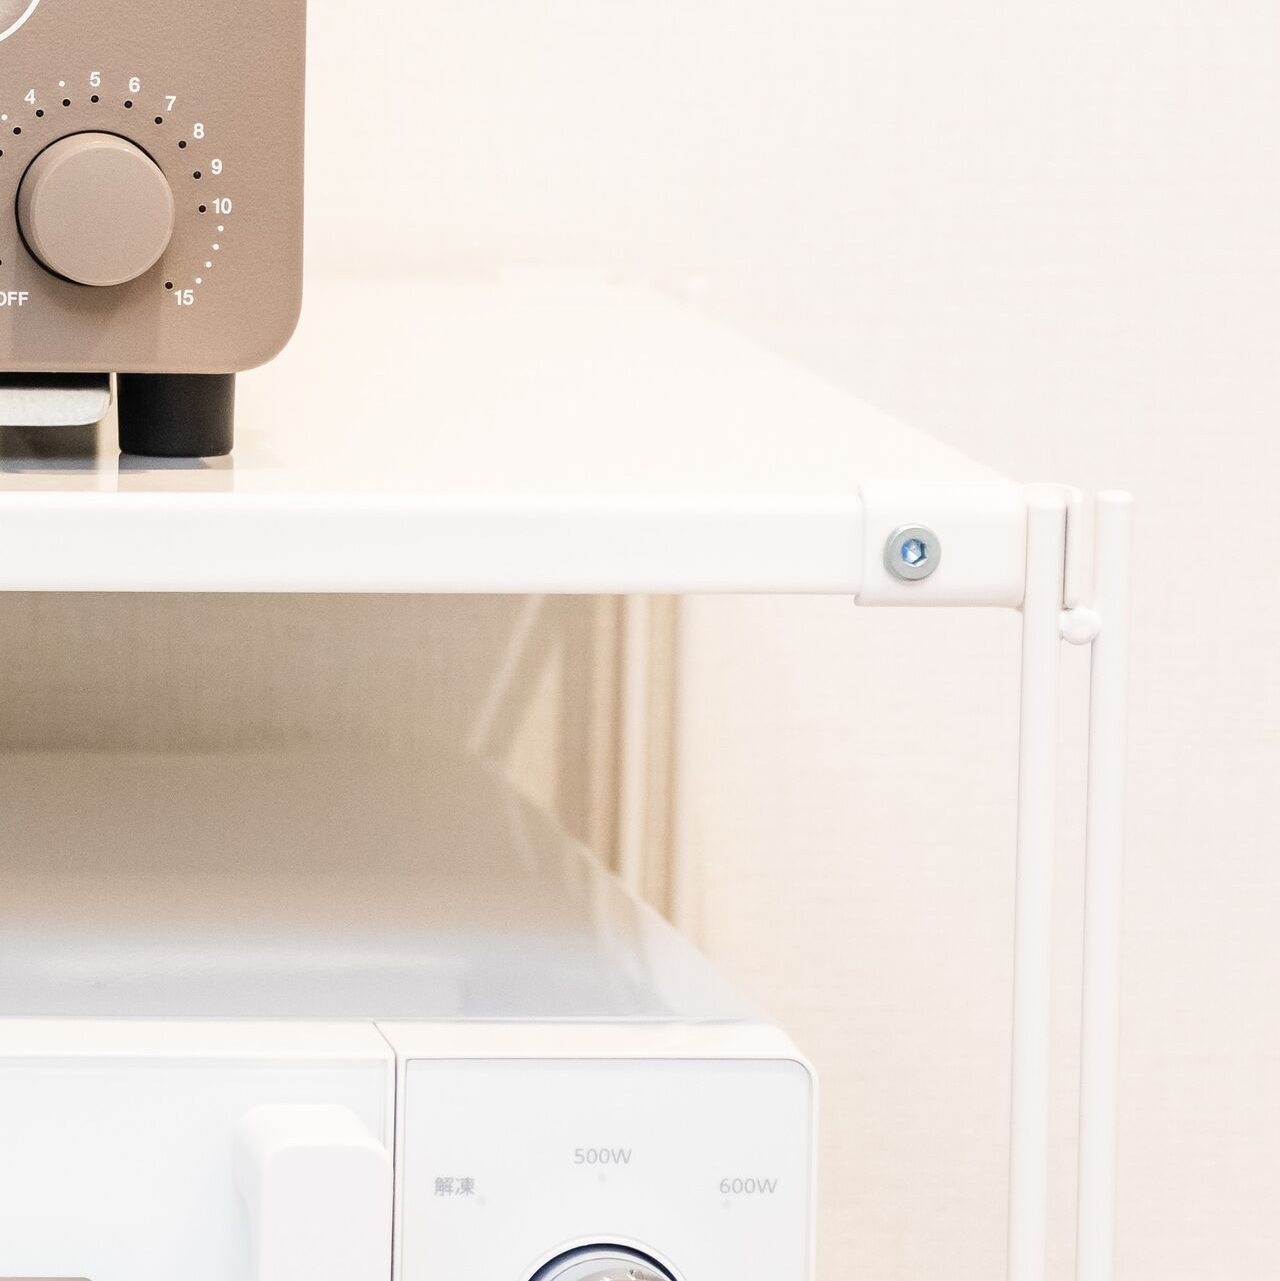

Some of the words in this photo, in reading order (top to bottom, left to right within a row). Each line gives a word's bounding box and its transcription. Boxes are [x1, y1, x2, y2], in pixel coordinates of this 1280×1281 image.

[89, 71, 101, 88] 5
[128, 76, 141, 93] 6
[24, 88, 36, 105] 4
[165, 95, 177, 112] 7
[192, 122, 205, 140] 8
[211, 158, 223, 175] 9
[212, 197, 233, 215] 10
[174, 289, 195, 306] 15
[574, 1147, 633, 1165] 500W
[434, 1176, 475, 1197] 解凍
[719, 1177, 778, 1195] 600W
